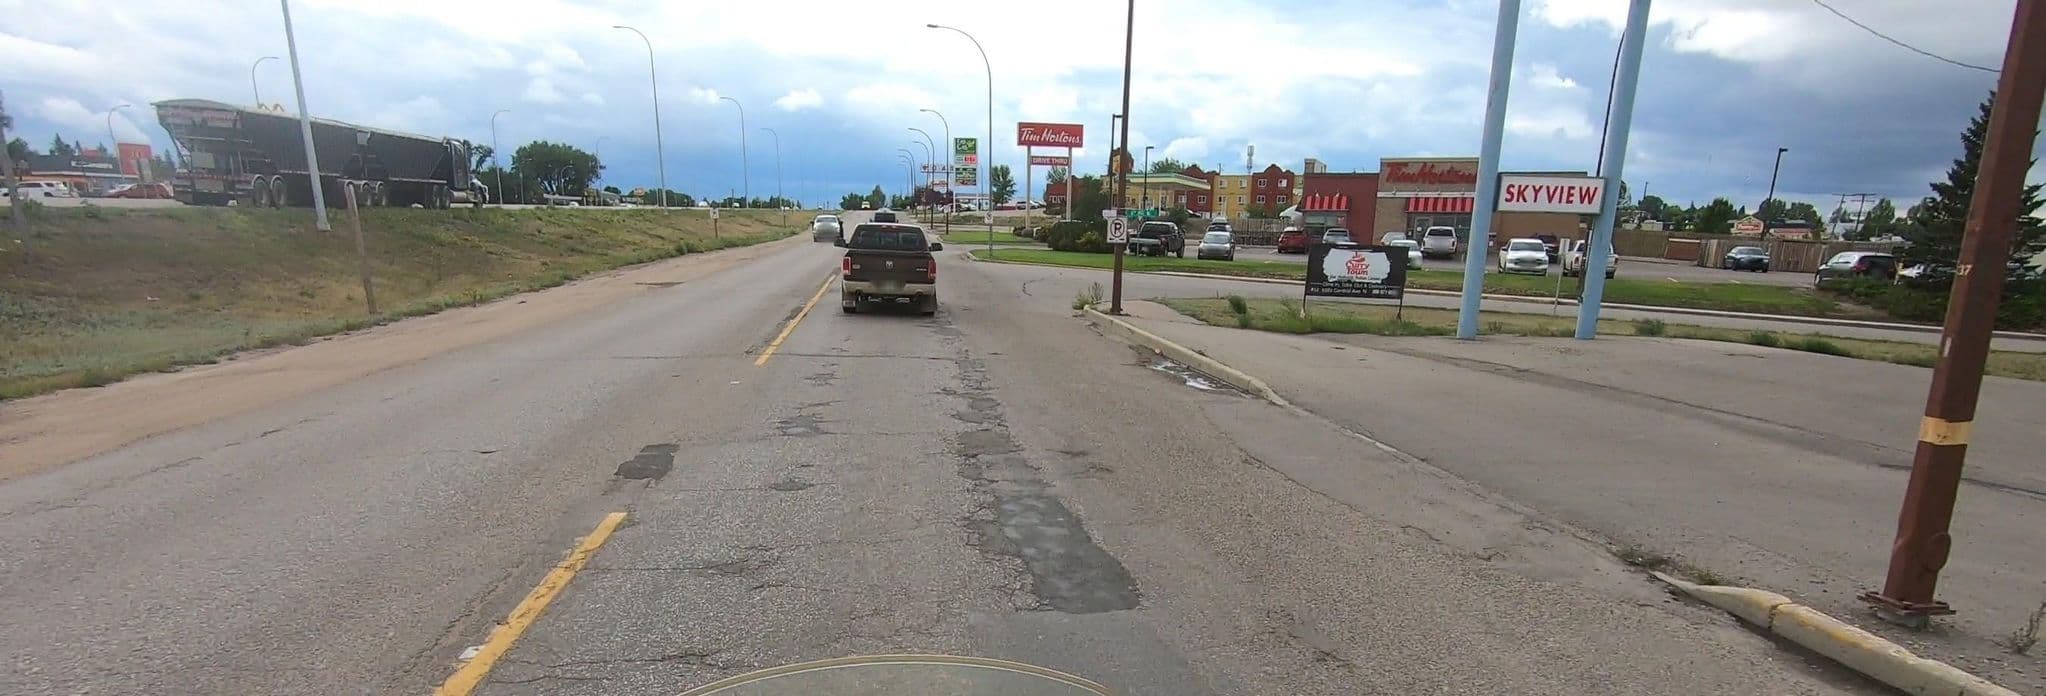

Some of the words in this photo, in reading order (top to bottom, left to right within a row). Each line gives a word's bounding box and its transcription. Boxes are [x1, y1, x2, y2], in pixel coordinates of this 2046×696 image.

[1021, 127, 1041, 142] Tim
[1041, 128, 1080, 144] Hortons
[1386, 162, 1417, 183] Tim
[1504, 183, 1598, 205] SKYVIEW
